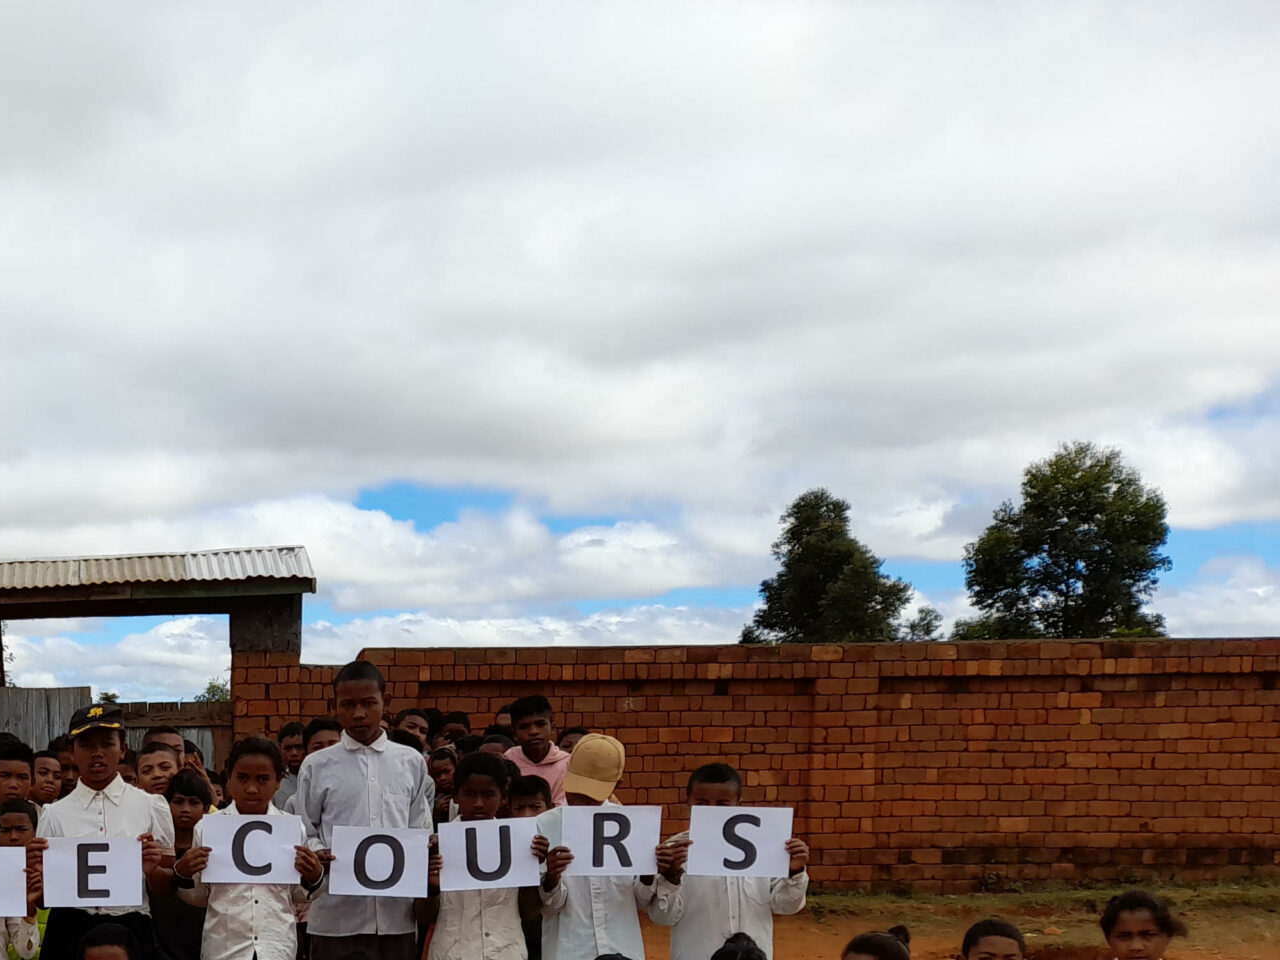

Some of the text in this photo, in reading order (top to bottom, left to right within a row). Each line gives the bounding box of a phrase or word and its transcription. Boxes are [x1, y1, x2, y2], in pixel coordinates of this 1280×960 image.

[231, 820, 273, 877] C
[353, 833, 406, 891] O
[464, 824, 512, 882] U
[592, 812, 633, 868] R
[722, 813, 761, 871] S
[76, 842, 111, 899] E
